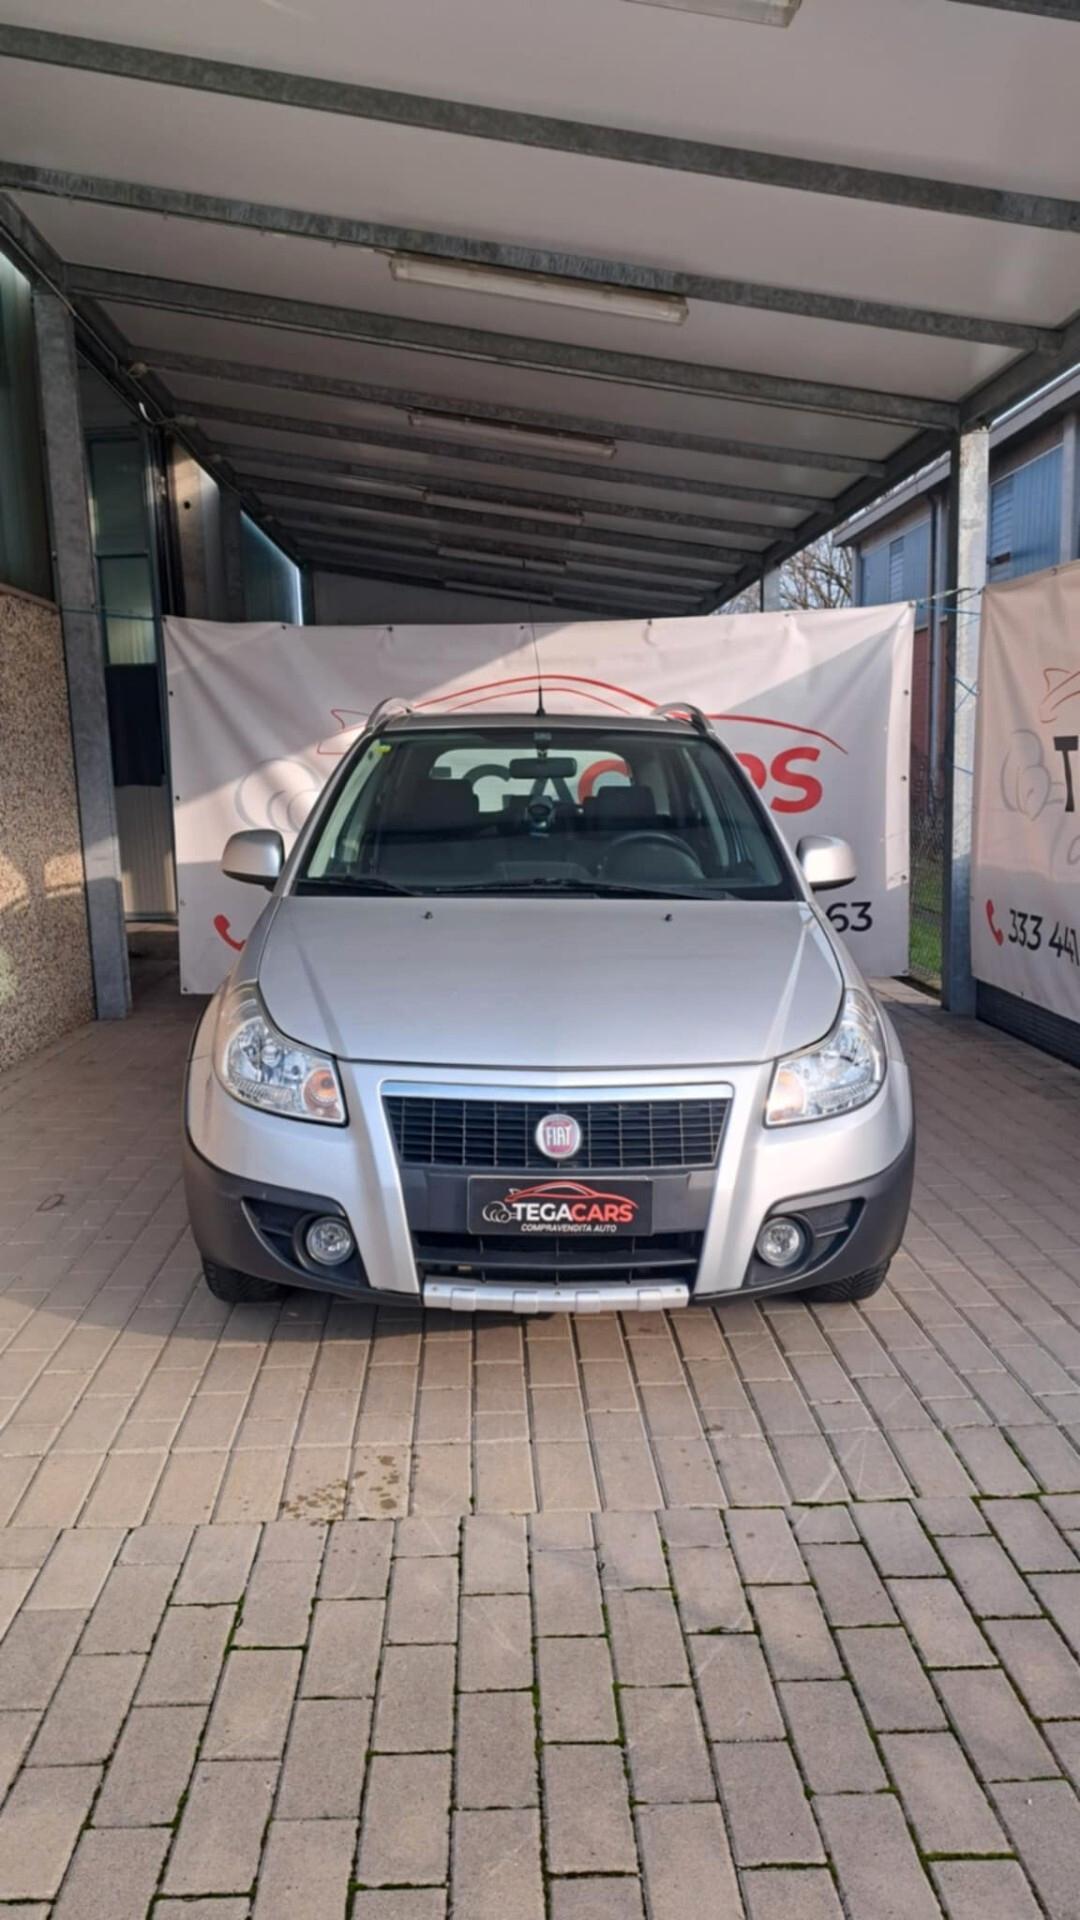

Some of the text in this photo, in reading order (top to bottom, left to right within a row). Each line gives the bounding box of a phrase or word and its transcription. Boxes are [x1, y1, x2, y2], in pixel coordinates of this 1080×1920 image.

[1008, 908, 1043, 951] 333
[546, 1126, 571, 1146] FIAT
[512, 1203, 633, 1222] TEGACARS
[521, 1223, 617, 1232] COMPRAVENDITA AUTO
